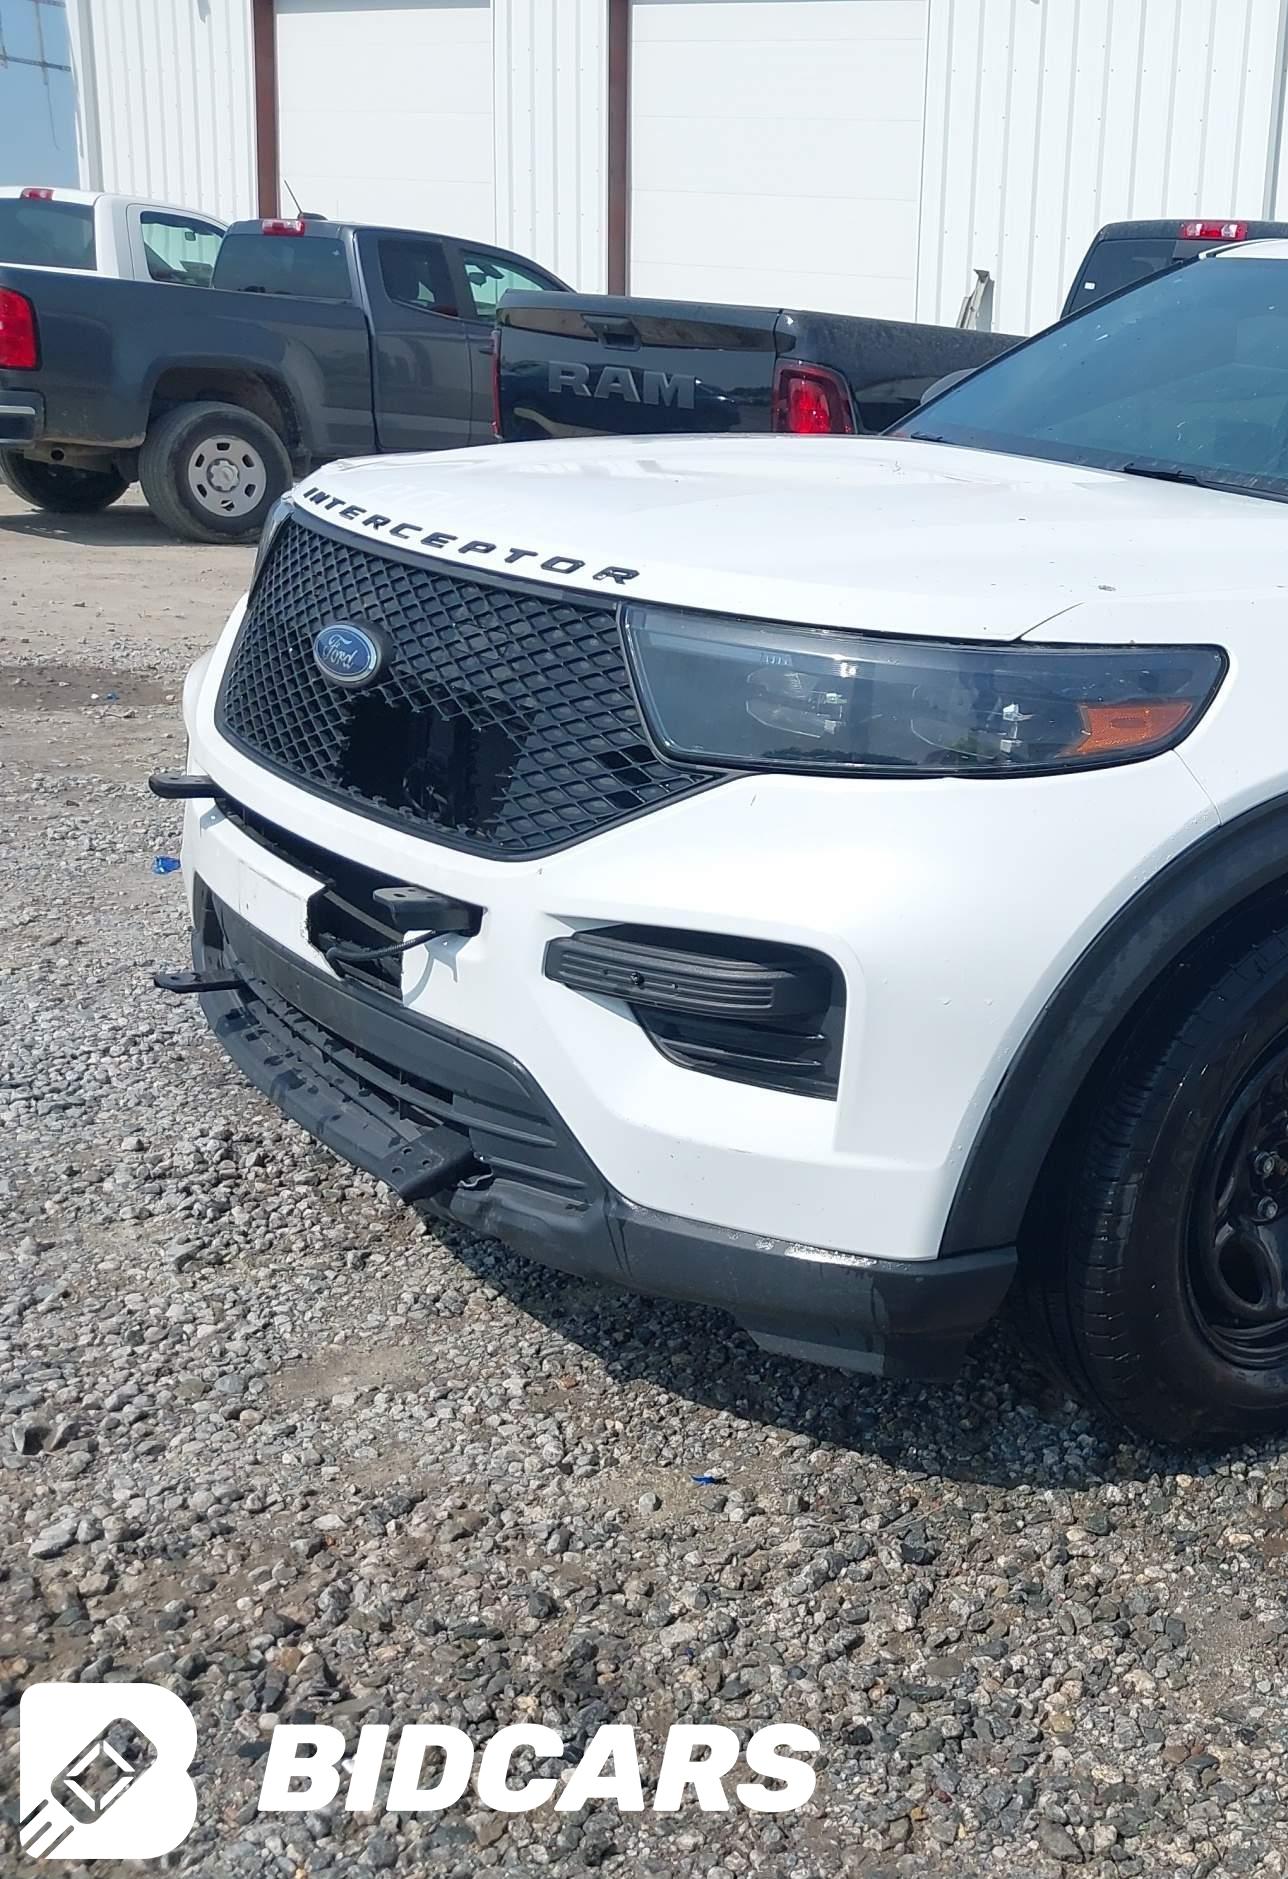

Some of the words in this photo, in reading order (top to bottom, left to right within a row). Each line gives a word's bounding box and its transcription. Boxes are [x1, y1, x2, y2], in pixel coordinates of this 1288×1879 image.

[548, 360, 695, 409] RAM
[303, 487, 641, 585] INTERCEPTOR
[323, 633, 358, 669] Ford
